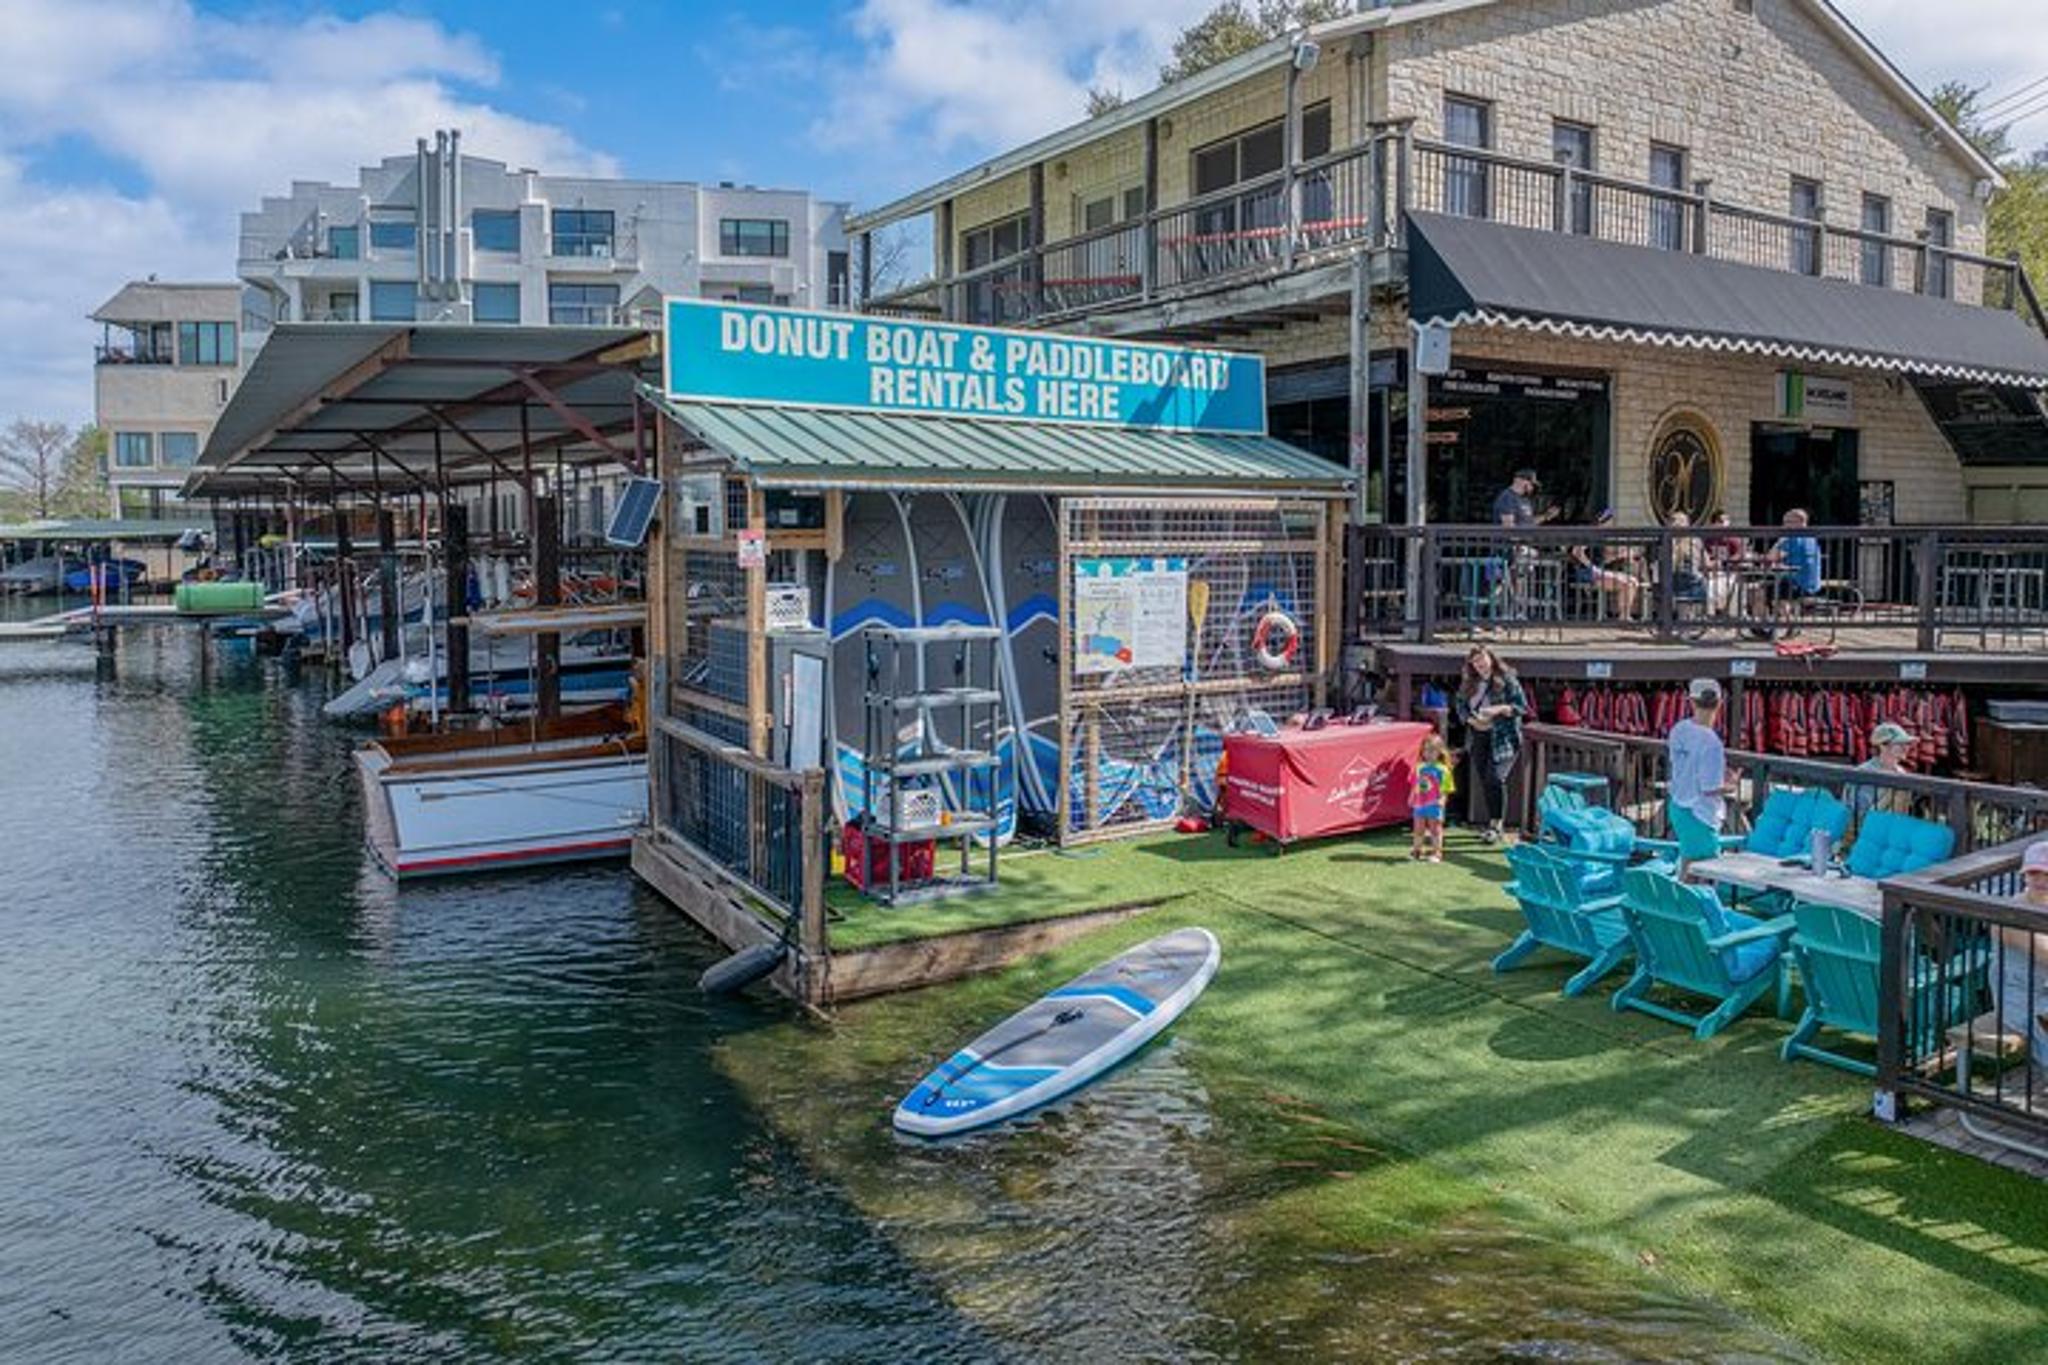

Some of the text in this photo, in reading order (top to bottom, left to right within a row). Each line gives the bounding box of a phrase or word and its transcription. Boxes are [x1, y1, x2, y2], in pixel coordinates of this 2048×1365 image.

[722, 313, 1229, 390] DONUT BOAT & PADDLEBOARD
[872, 369, 1119, 418] RENTALS HERE
